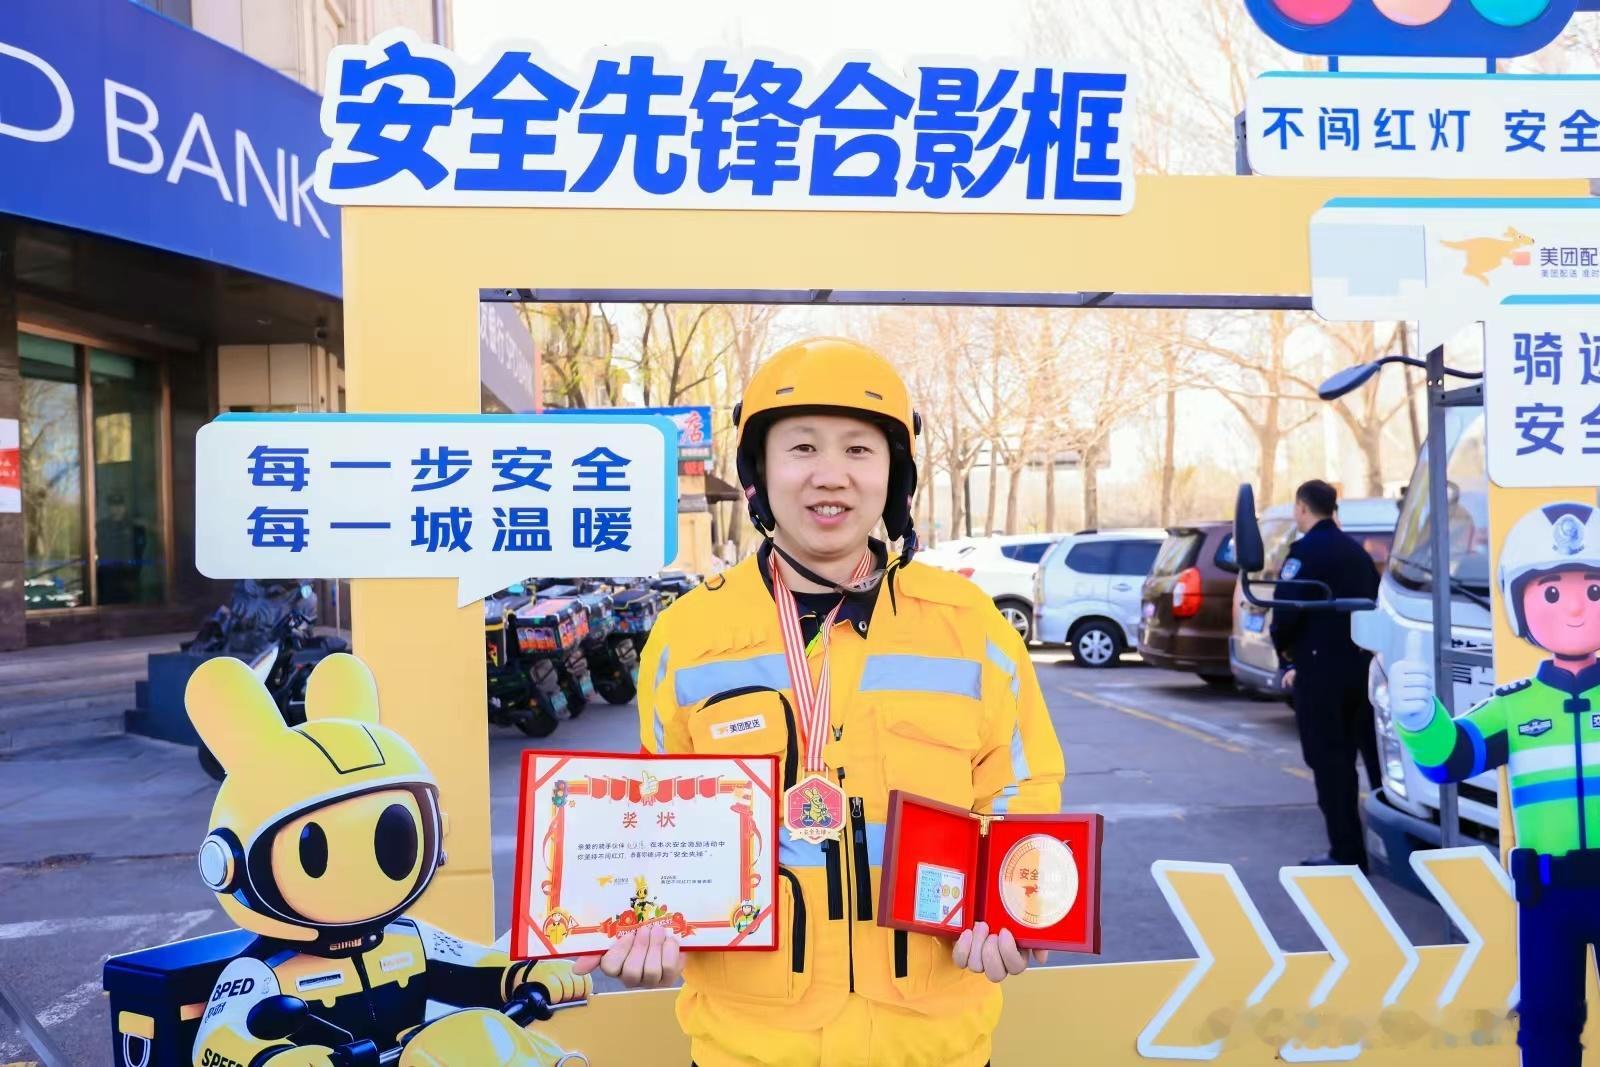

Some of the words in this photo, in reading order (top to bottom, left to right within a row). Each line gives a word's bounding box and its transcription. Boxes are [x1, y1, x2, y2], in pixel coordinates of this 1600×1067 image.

[329, 41, 1127, 201] 安全先锋合影框
[1262, 107, 1471, 153] 不闯红灯
[1504, 109, 1600, 152] 安全
[103, 78, 331, 239] BANK
[247, 445, 632, 492] 每一步安全
[247, 506, 632, 553] 每一城温暖
[729, 718, 761, 733] 美团配送
[622, 811, 676, 829] 奖状
